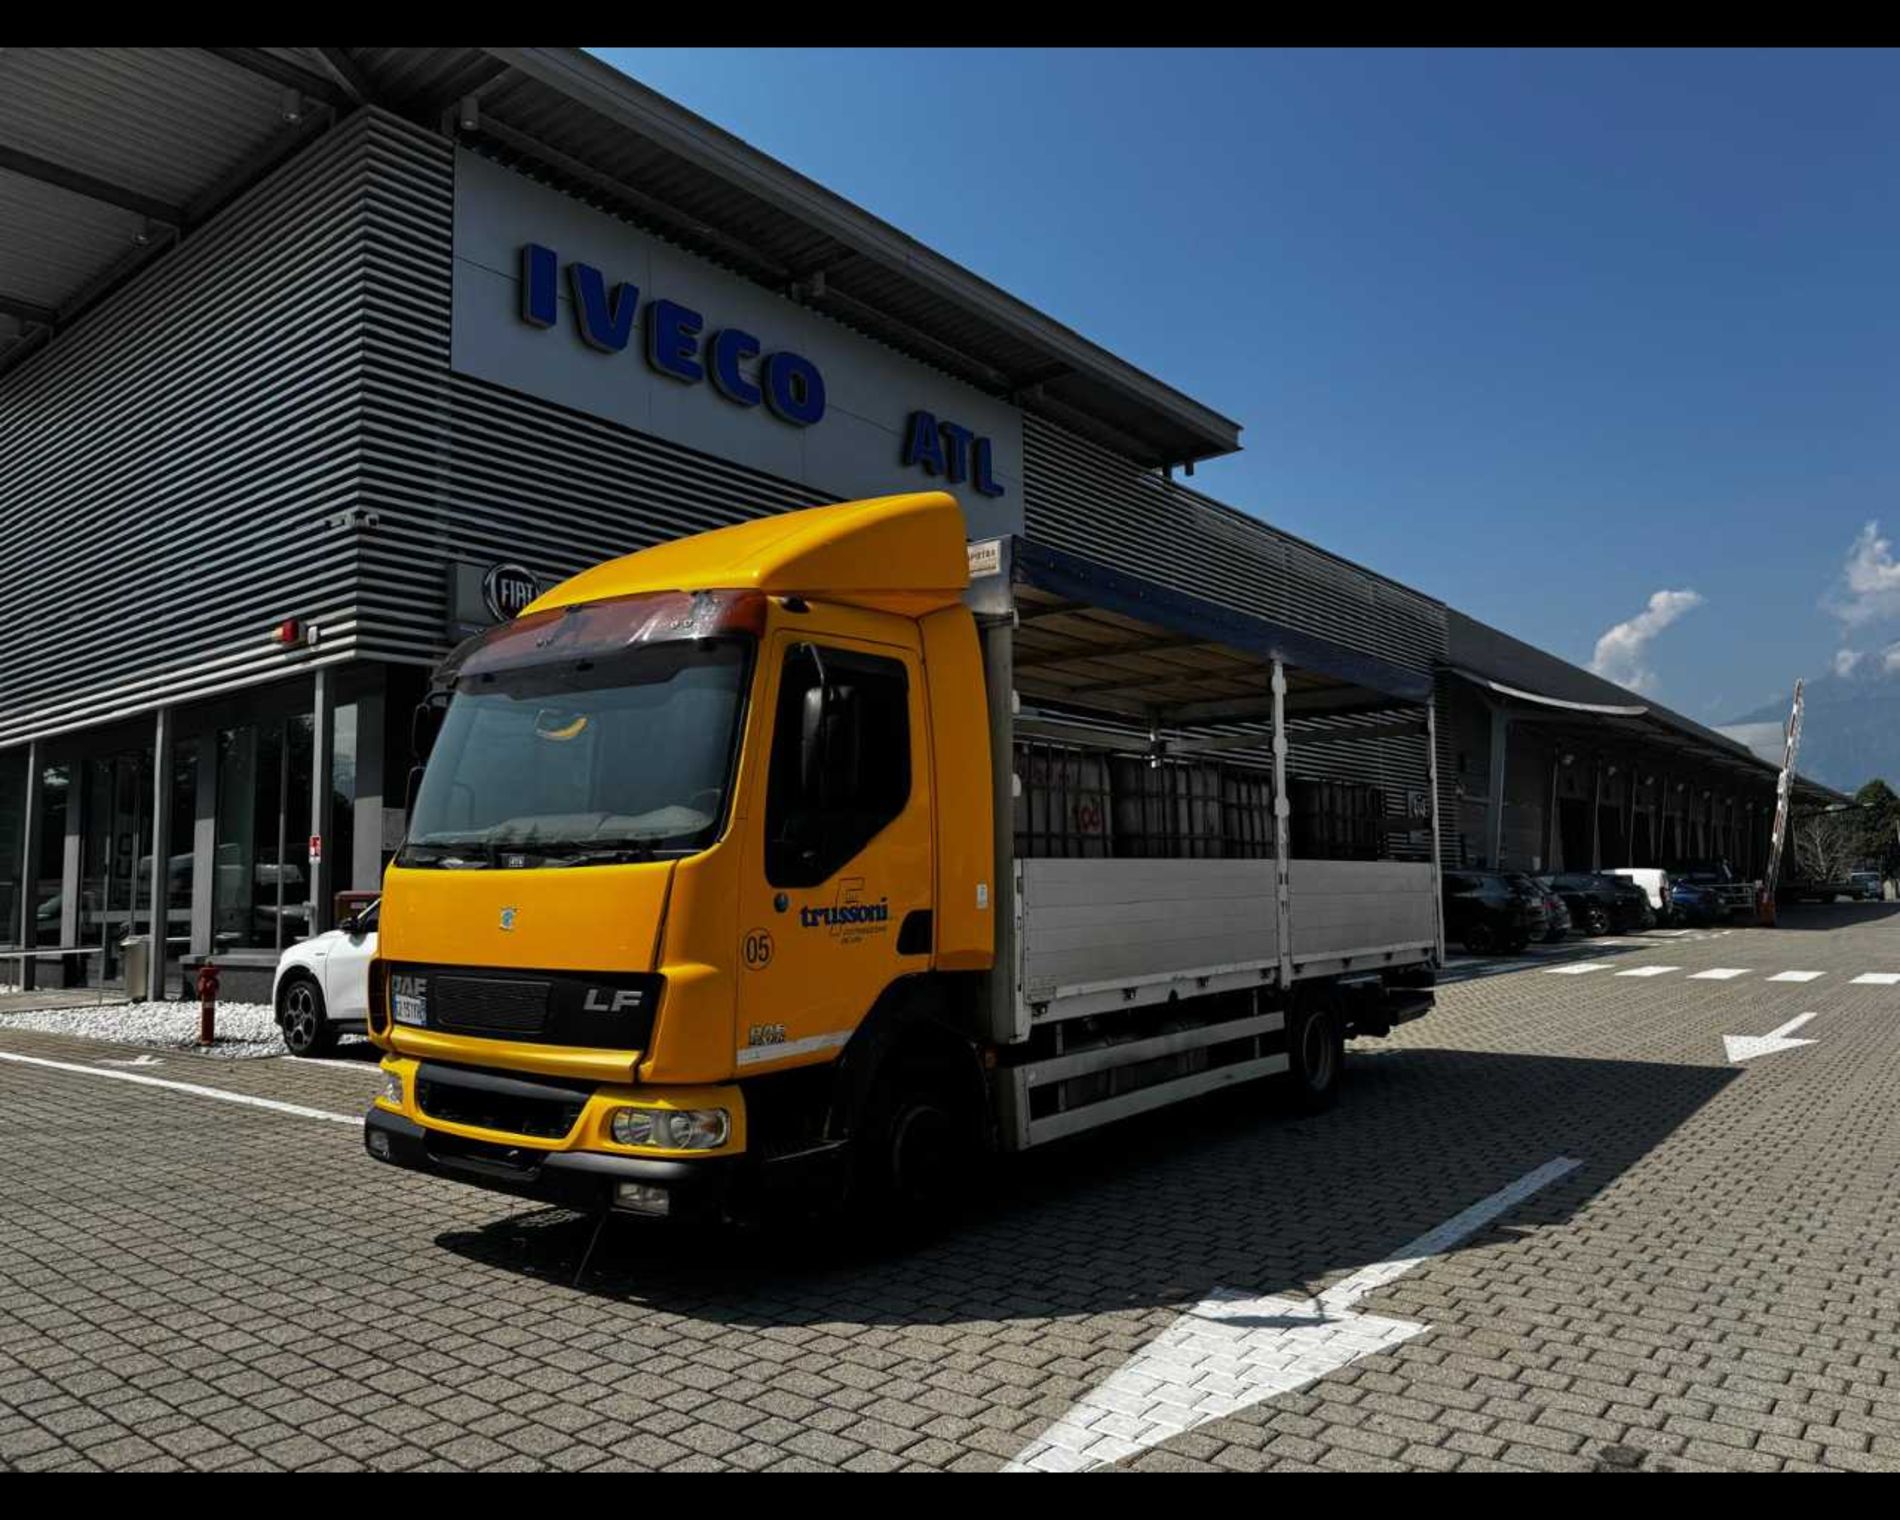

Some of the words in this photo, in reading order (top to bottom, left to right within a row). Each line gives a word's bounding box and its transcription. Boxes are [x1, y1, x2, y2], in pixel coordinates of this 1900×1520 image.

[521, 243, 826, 427] IVECO
[902, 410, 1004, 498] ATL
[499, 577, 534, 609] FIAT
[801, 897, 888, 927] trussoni
[746, 935, 770, 963] 05
[583, 988, 643, 1012] LF
